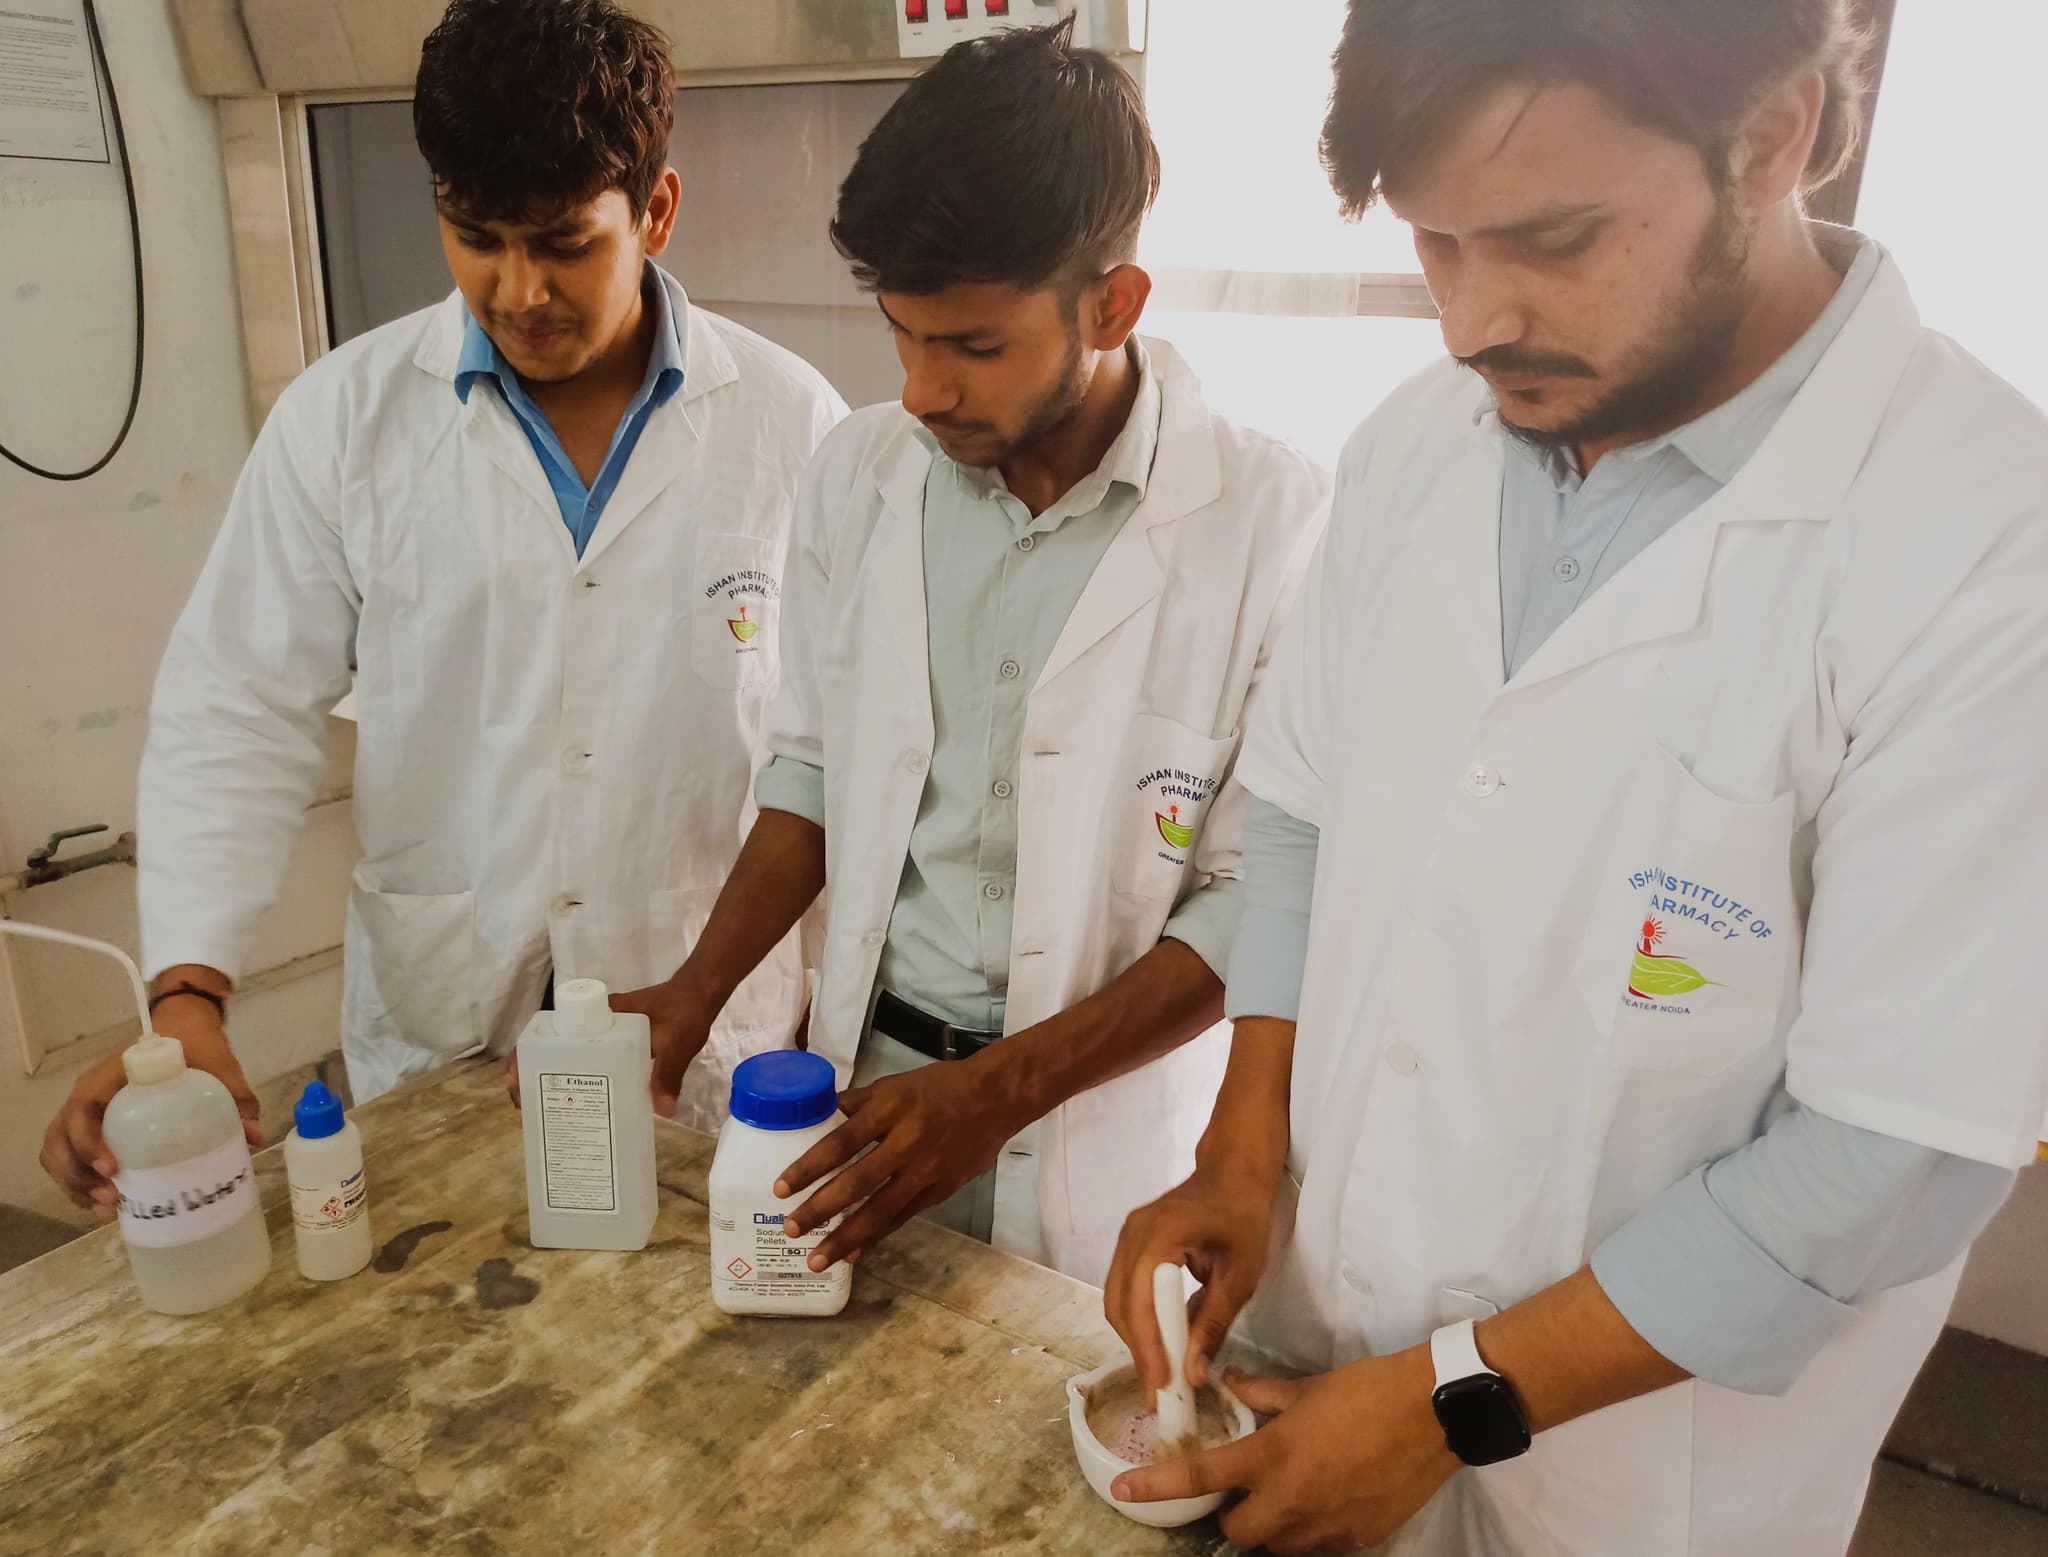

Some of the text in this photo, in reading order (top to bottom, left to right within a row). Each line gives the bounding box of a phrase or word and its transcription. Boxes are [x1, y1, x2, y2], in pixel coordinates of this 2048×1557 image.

[705, 574, 736, 599] ISHAN
[737, 570, 777, 590] INSTITUTE
[1136, 768, 1172, 790] ISHAN
[1161, 785, 1206, 802] PHARM
[1651, 894, 1739, 940] ARMACY
[1750, 920, 1772, 940] OF
[1622, 995, 1690, 1014] EATER NOIDA
[567, 1078, 602, 1086] Ethanol
